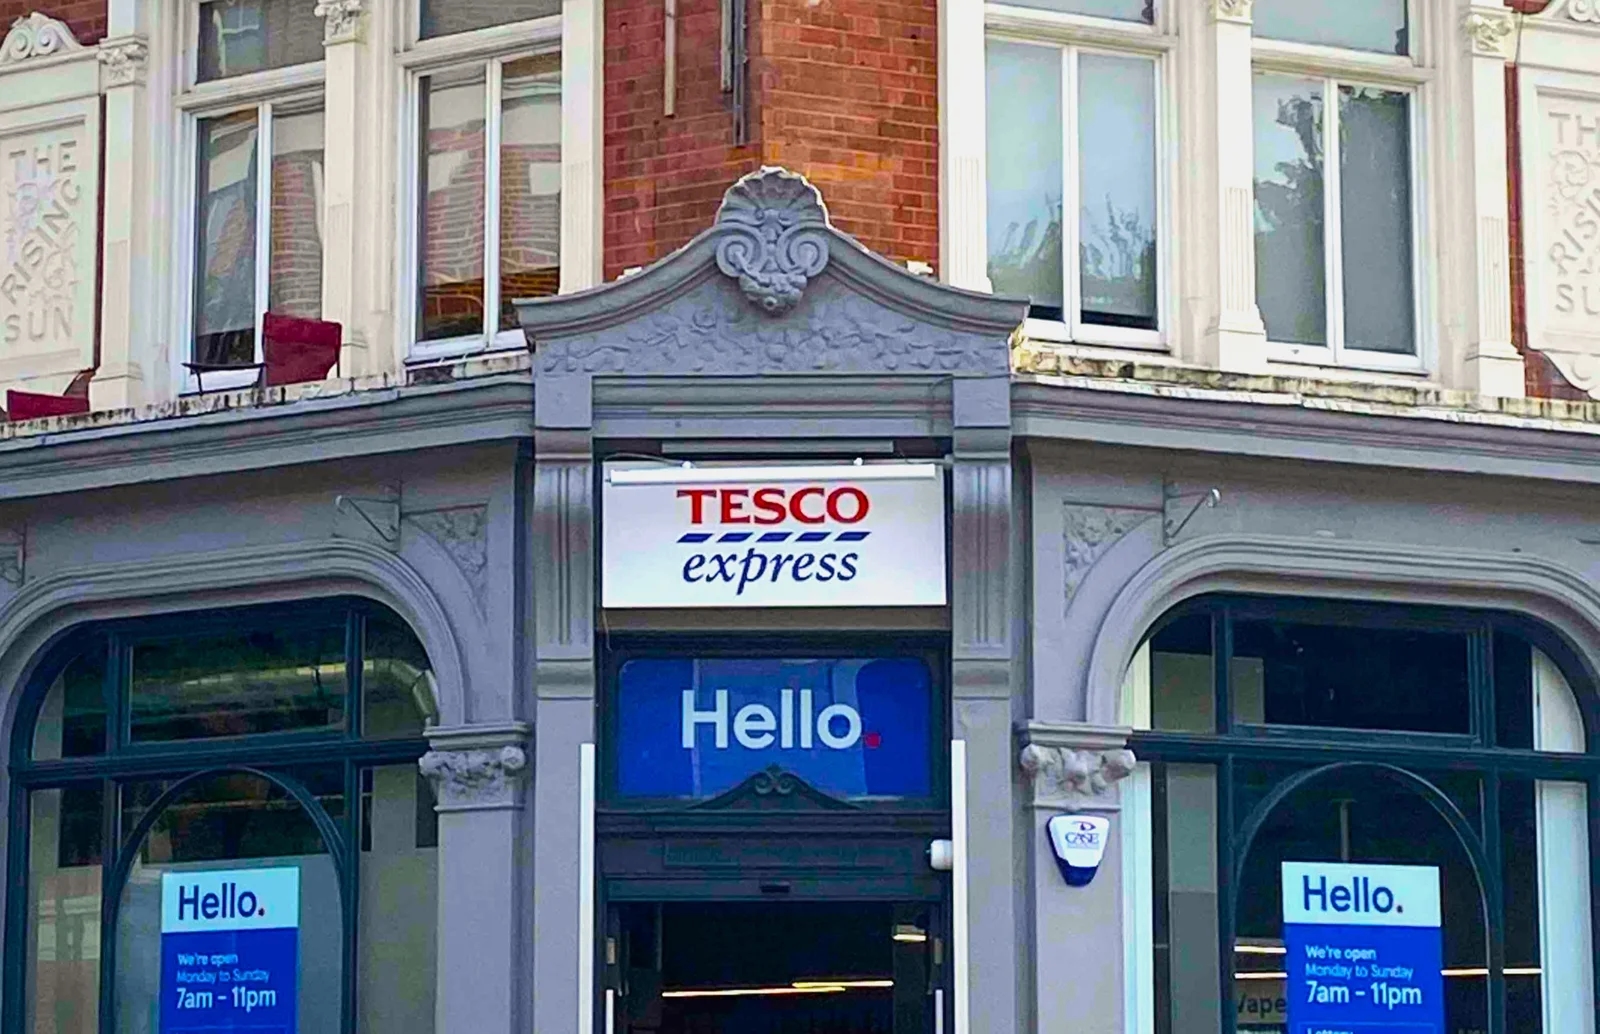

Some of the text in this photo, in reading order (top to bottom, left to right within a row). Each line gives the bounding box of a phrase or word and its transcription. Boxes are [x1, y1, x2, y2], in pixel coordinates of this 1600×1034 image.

[9, 140, 77, 181] THE
[4, 305, 72, 343] SUN
[677, 487, 870, 525] TESCO
[682, 548, 859, 596] express
[682, 689, 881, 749] Hello.
[178, 882, 265, 921] Hello.
[1303, 875, 1404, 914] Hello.
[177, 953, 238, 967] We're open
[1305, 945, 1377, 961] We're open
[1305, 963, 1413, 981] Monday to Sunday
[176, 968, 269, 984] Monday to Sunday
[176, 987, 213, 1009] 7am
[231, 986, 276, 1013] 11pm
[1306, 981, 1349, 1003] 7am
[1370, 982, 1422, 1010] 11pm
